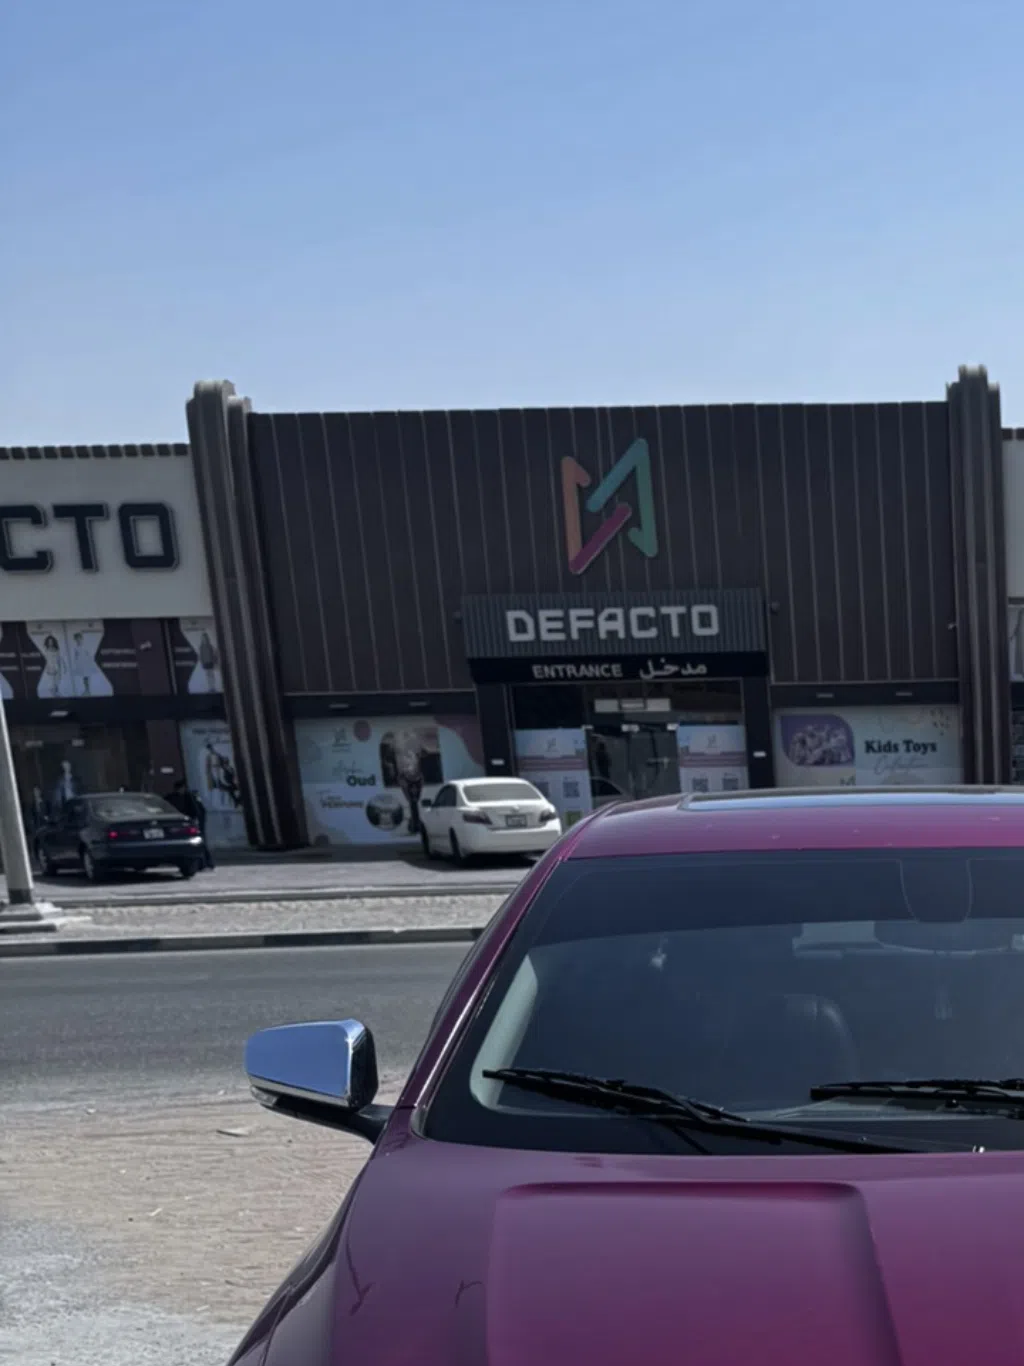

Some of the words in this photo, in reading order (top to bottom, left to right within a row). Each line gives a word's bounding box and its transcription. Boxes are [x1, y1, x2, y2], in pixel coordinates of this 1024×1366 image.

[0, 502, 180, 572] CTO
[505, 603, 720, 643] DEFACTO
[532, 664, 623, 679] ENTRANCE
[639, 657, 708, 680] مدخل
[864, 740, 899, 754] Kids
[902, 739, 938, 756] Toys
[346, 774, 376, 787] Oud
